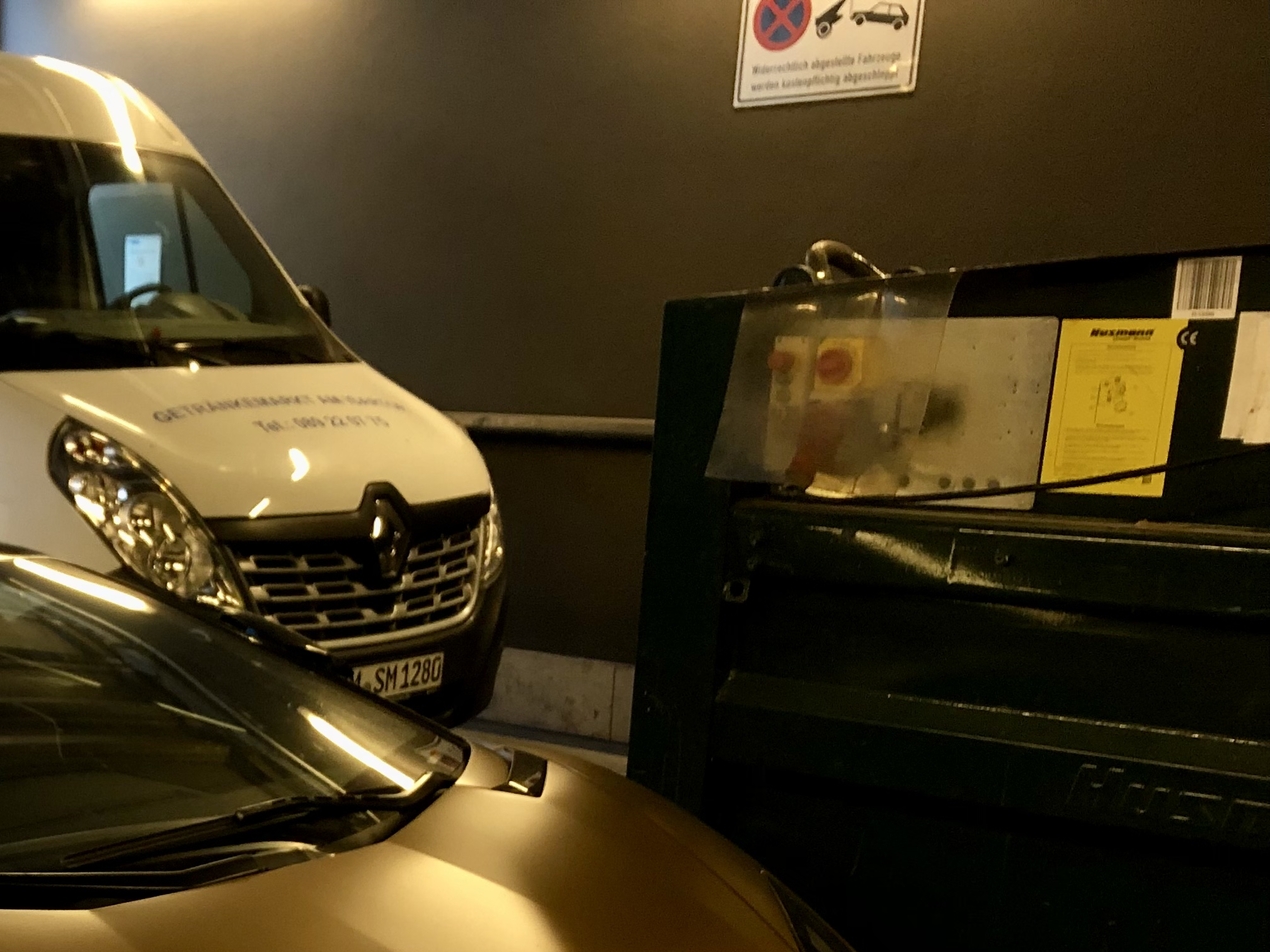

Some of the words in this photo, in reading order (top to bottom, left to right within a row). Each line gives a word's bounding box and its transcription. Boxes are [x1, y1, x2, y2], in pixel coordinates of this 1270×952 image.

[751, 60, 808, 75] Widerrechtlich
[811, 55, 855, 71] abgestellte
[857, 51, 901, 65] Fahrzeuge
[750, 80, 779, 92] werden
[781, 74, 840, 89] kostenpflichtig
[843, 69, 899, 85] abgeschleppt
[373, 663, 398, 693] SM
[400, 656, 441, 689] 1280
